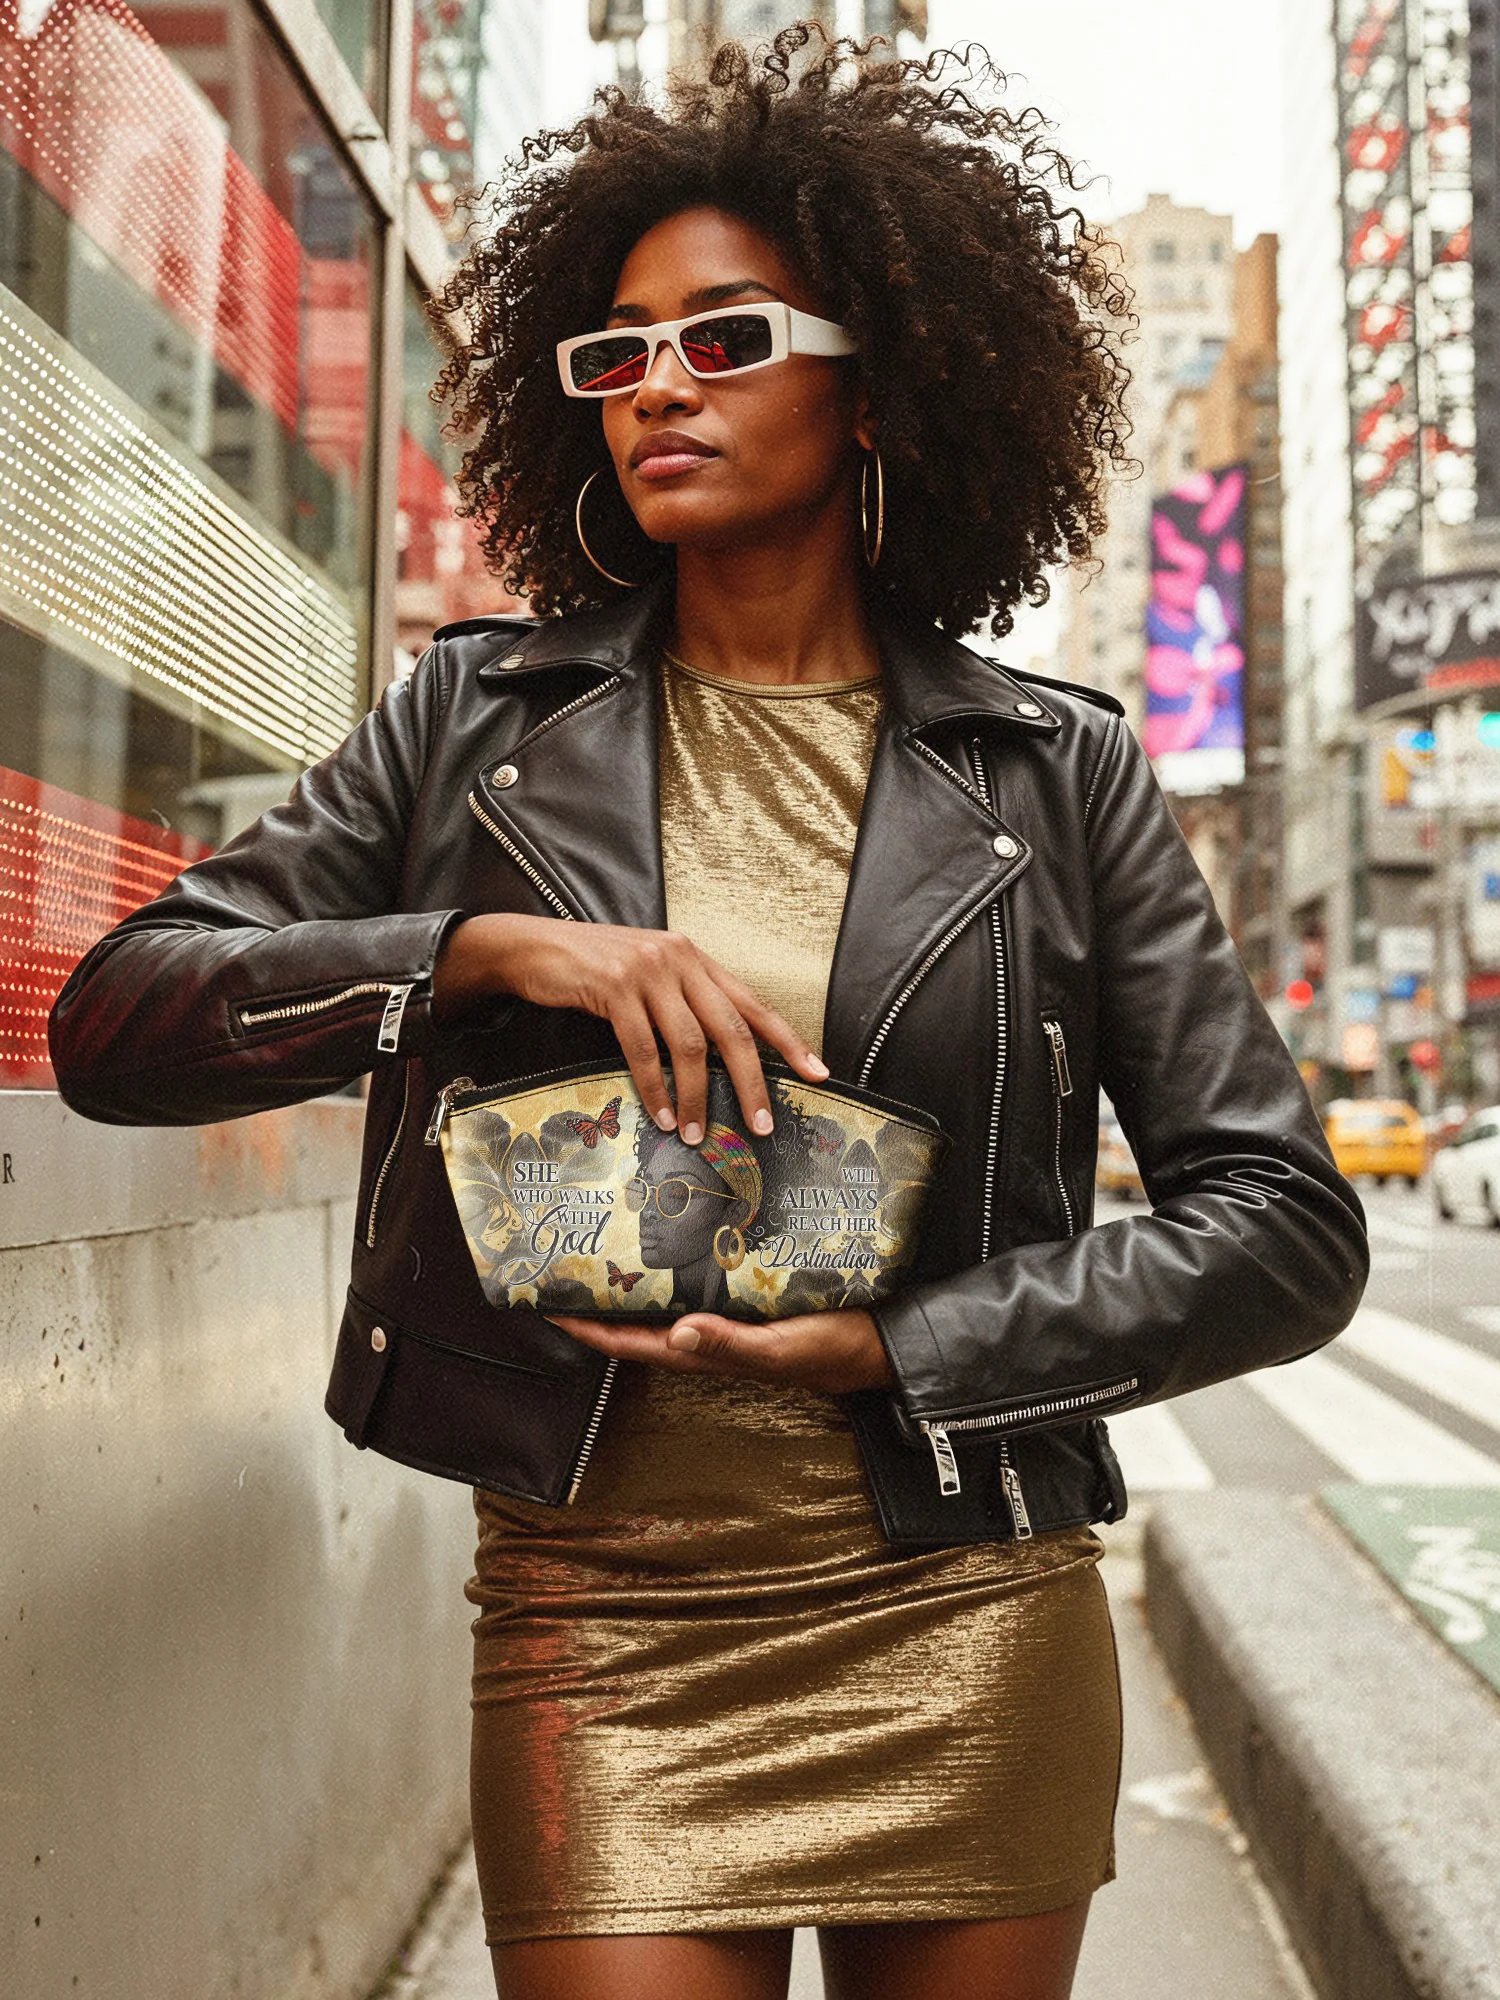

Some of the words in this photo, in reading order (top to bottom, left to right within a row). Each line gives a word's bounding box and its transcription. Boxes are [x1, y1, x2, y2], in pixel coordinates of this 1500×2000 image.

[514, 1161, 559, 1183] SHE
[842, 1168, 879, 1183] WILL
[514, 1189, 553, 1203] WHO
[558, 1190, 615, 1205] WALKS
[781, 1188, 878, 1210] ALWAYS
[557, 1211, 600, 1225] WITH
[789, 1216, 842, 1231] REACH
[847, 1217, 878, 1232] HER
[503, 1204, 612, 1286] God
[760, 1234, 879, 1270] Destination
